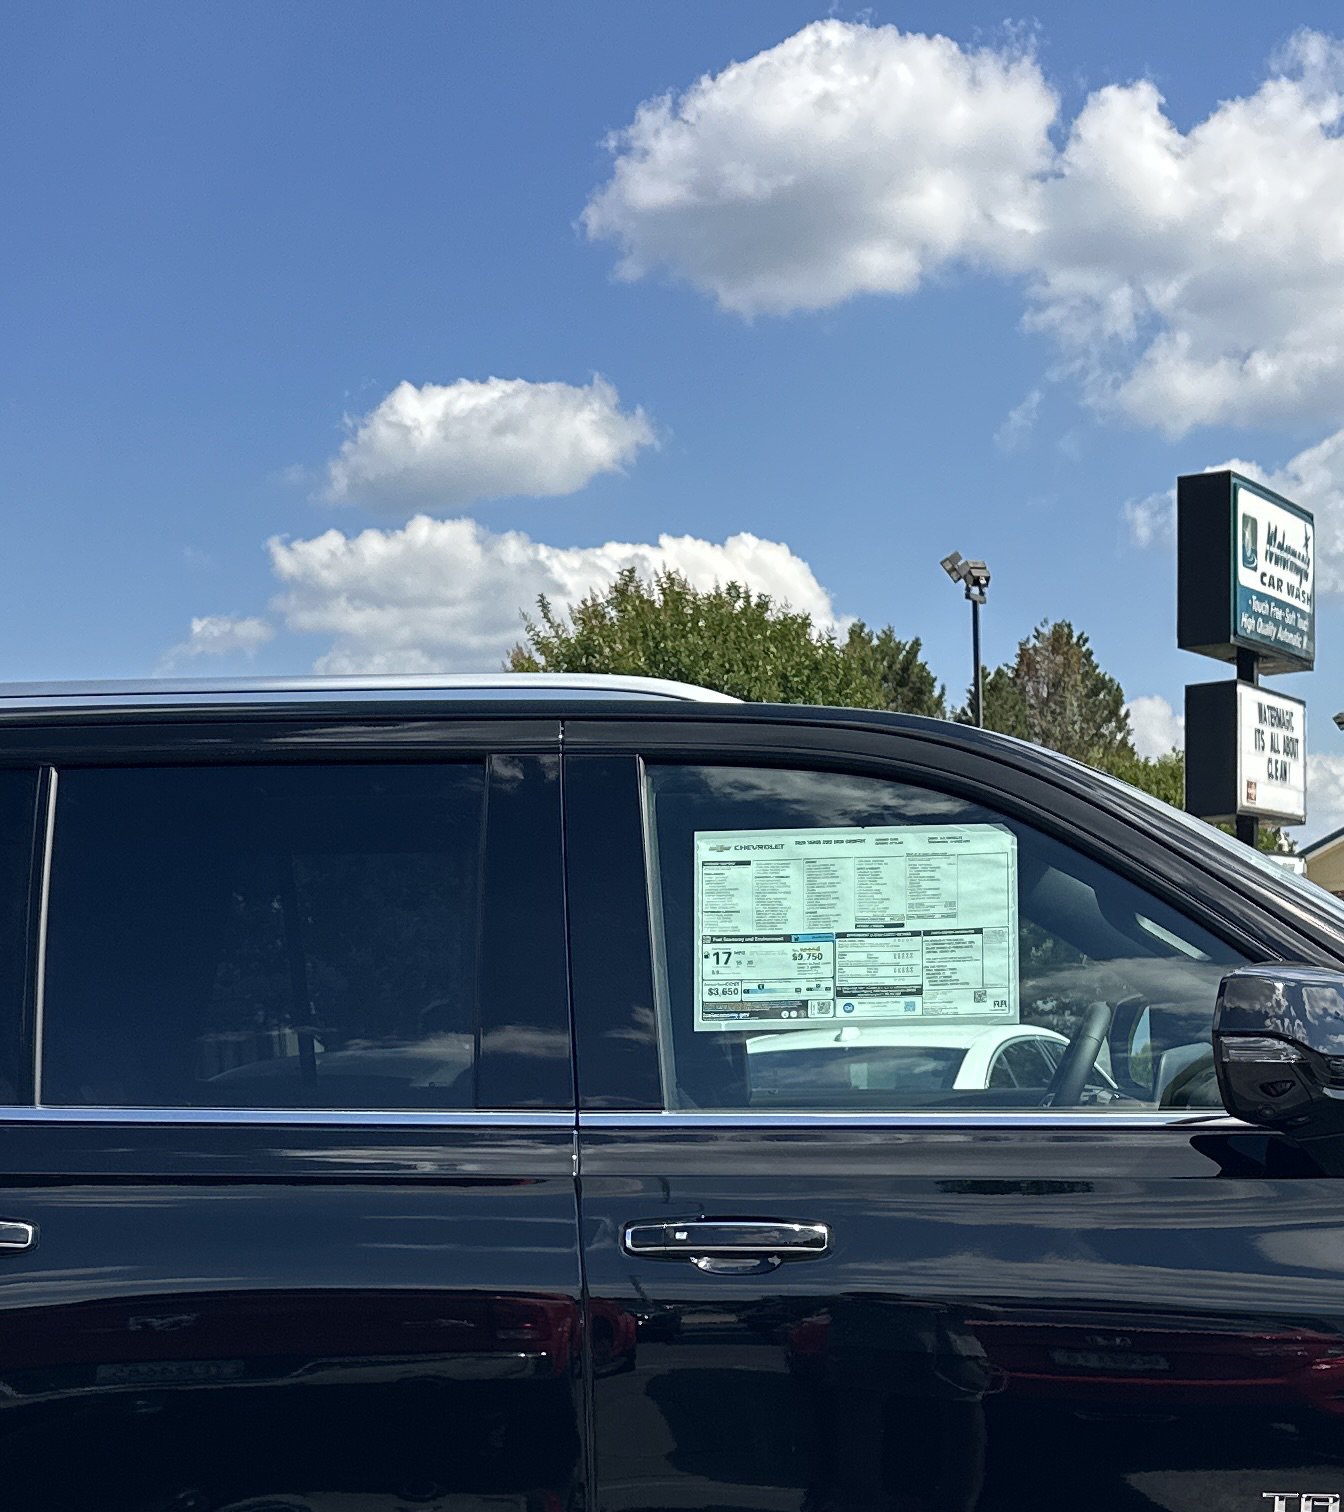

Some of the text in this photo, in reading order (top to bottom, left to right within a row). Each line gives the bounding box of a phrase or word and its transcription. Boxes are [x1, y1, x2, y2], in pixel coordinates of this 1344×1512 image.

[1260, 571, 1312, 606] CAR WASH
[1254, 727, 1299, 760] ITS ALL ABOUT
[733, 843, 785, 851] CHEVROLET
[712, 951, 732, 966] 17
[707, 987, 739, 997] $3,650
